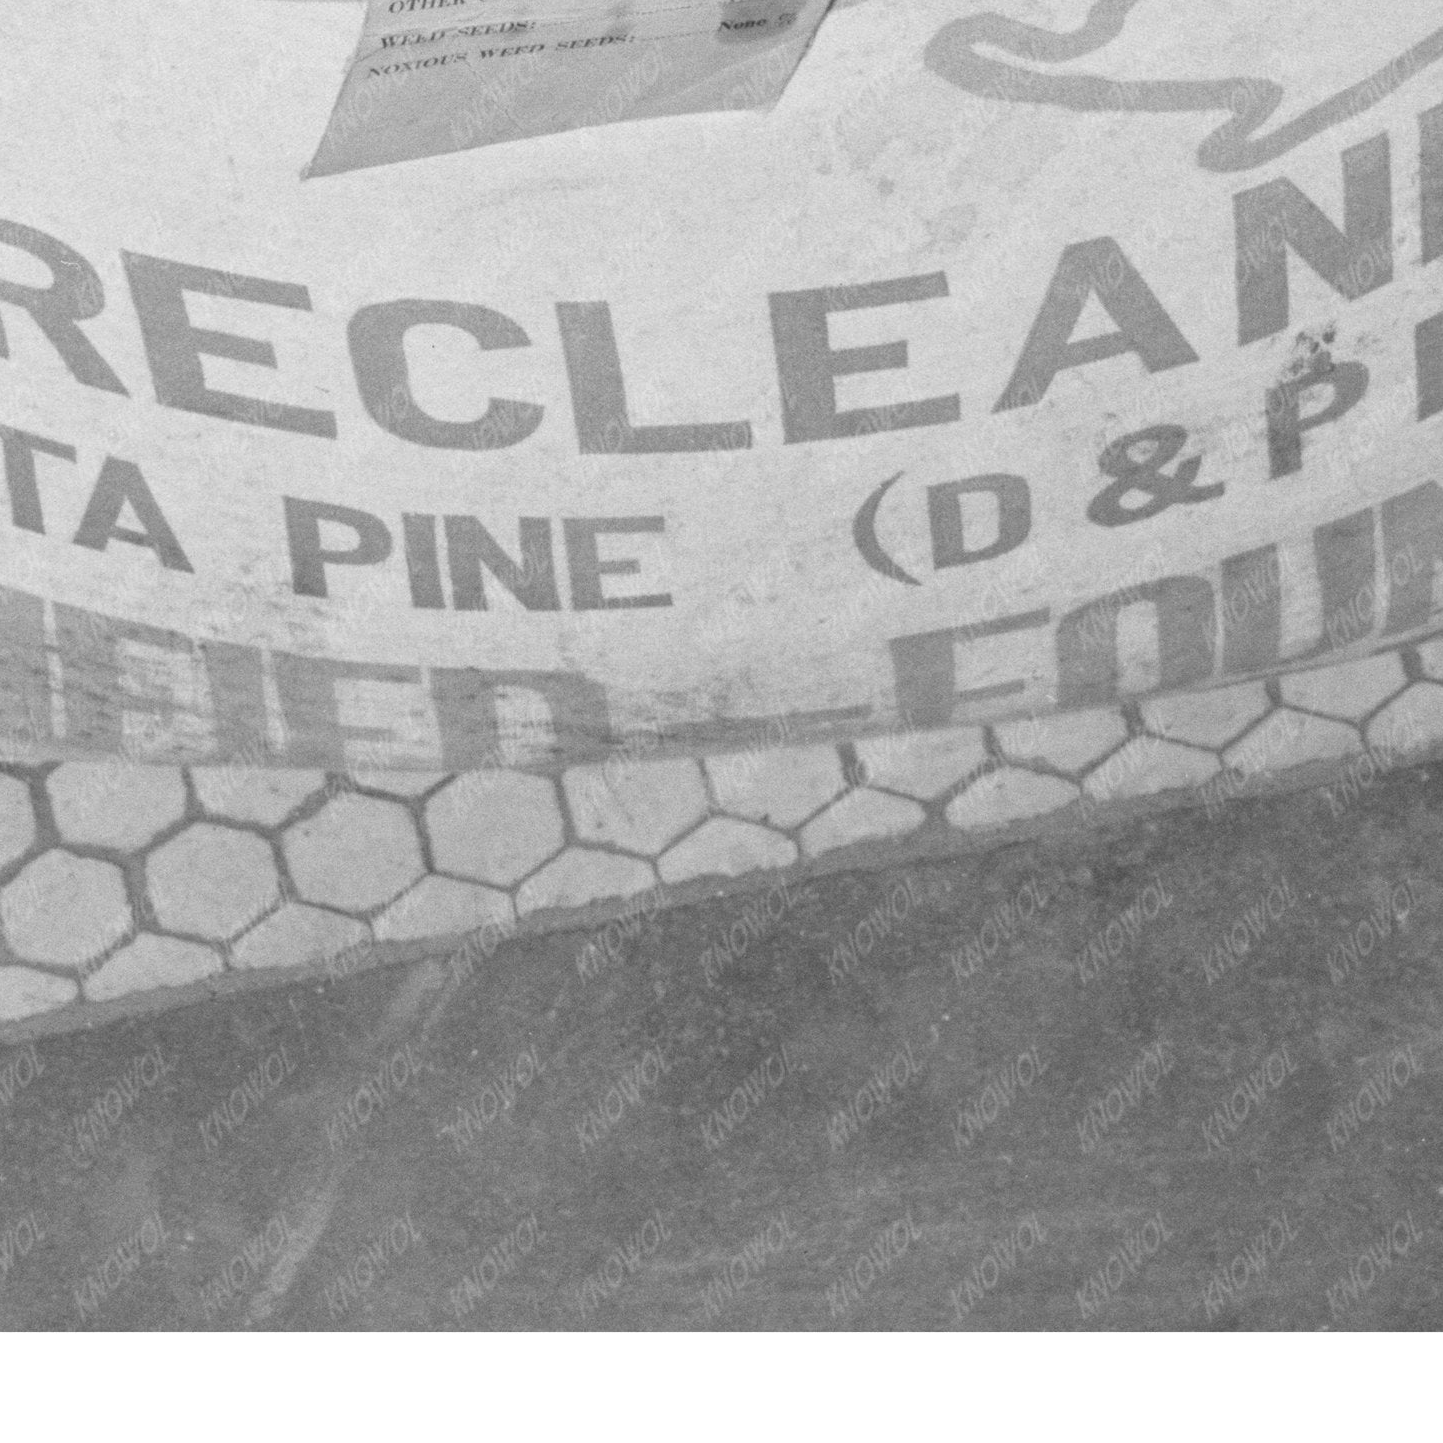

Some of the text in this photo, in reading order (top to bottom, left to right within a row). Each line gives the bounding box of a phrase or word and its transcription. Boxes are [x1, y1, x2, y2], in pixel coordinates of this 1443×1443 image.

[366, 51, 468, 80] NOXIOUS
[479, 42, 545, 61] WEED
[555, 33, 637, 52] SEEDS:
[716, 15, 768, 34] None
[379, 28, 446, 51] WEED
[456, 19, 538, 40] SEEDS:
[281, 491, 674, 615] PINE
